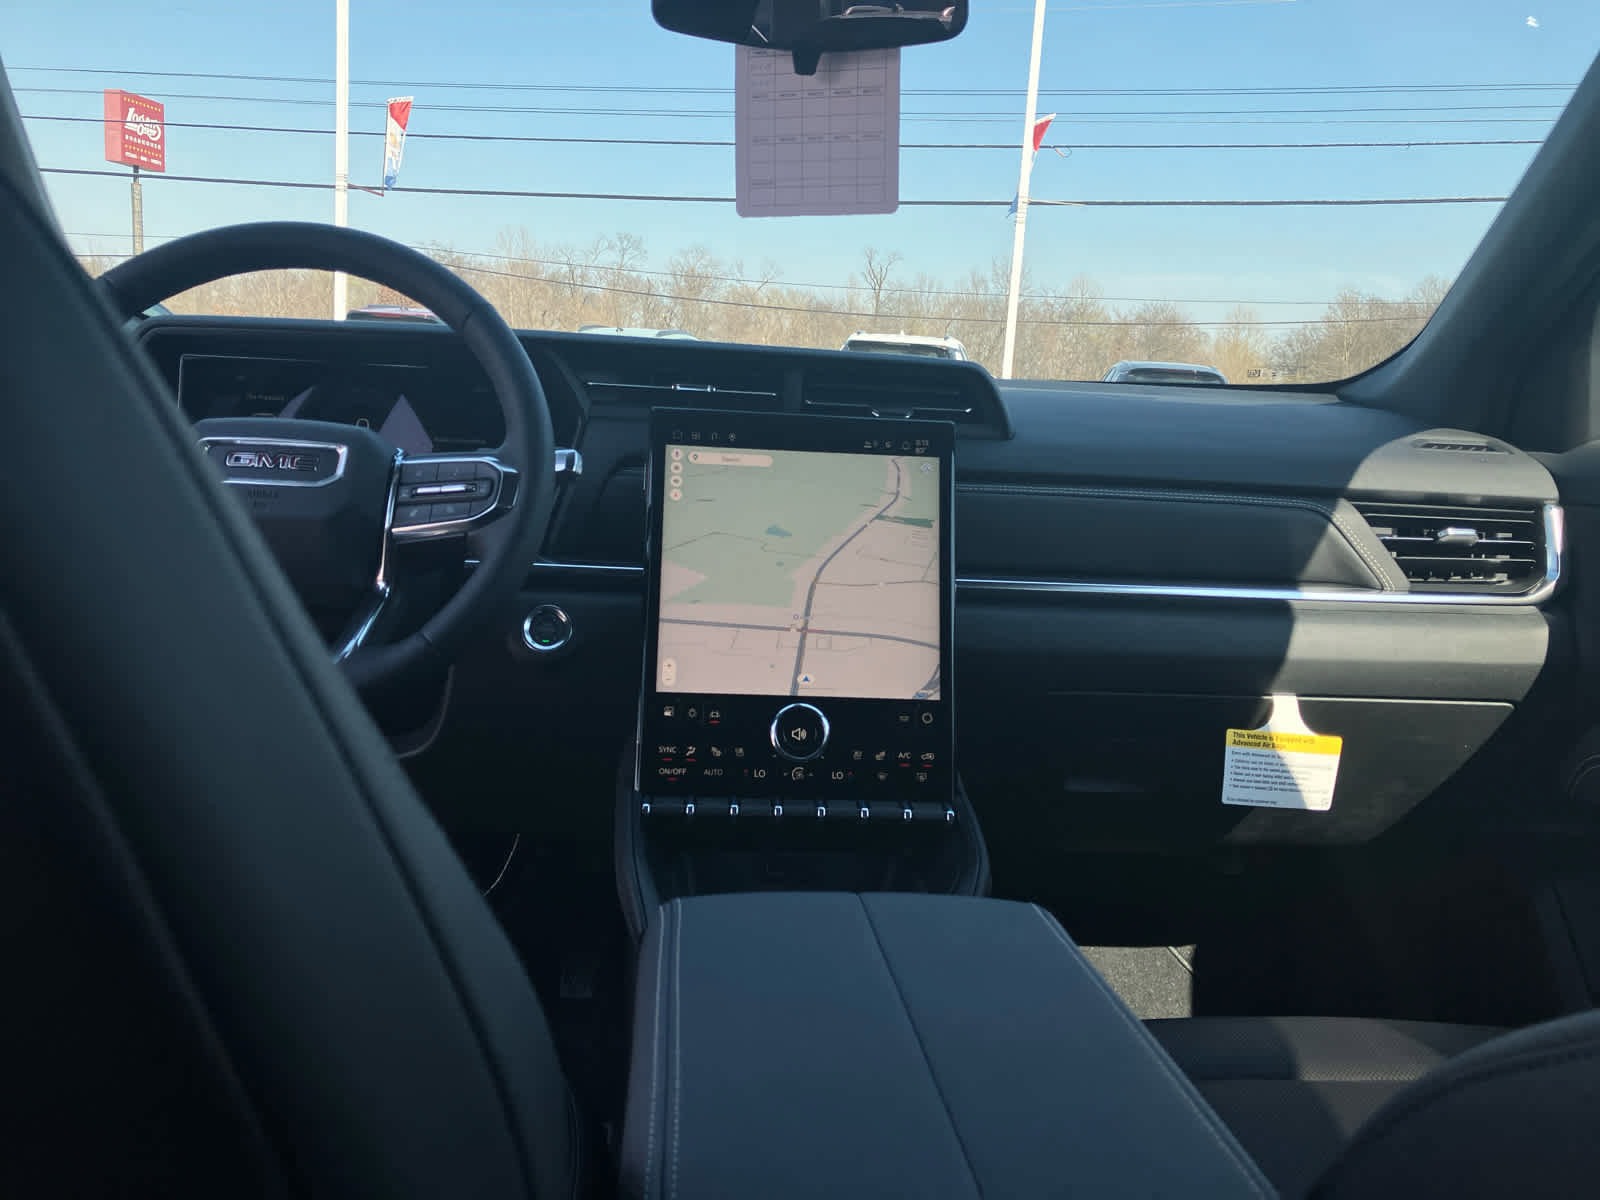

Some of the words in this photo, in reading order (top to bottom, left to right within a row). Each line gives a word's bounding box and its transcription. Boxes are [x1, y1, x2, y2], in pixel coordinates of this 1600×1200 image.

[226, 452, 319, 470] GMC
[1247, 733, 1268, 741] Vehicle
[658, 767, 687, 775] ON/OFF
[704, 768, 723, 776] AUTO
[754, 768, 766, 778] LO
[831, 771, 844, 780] LO
